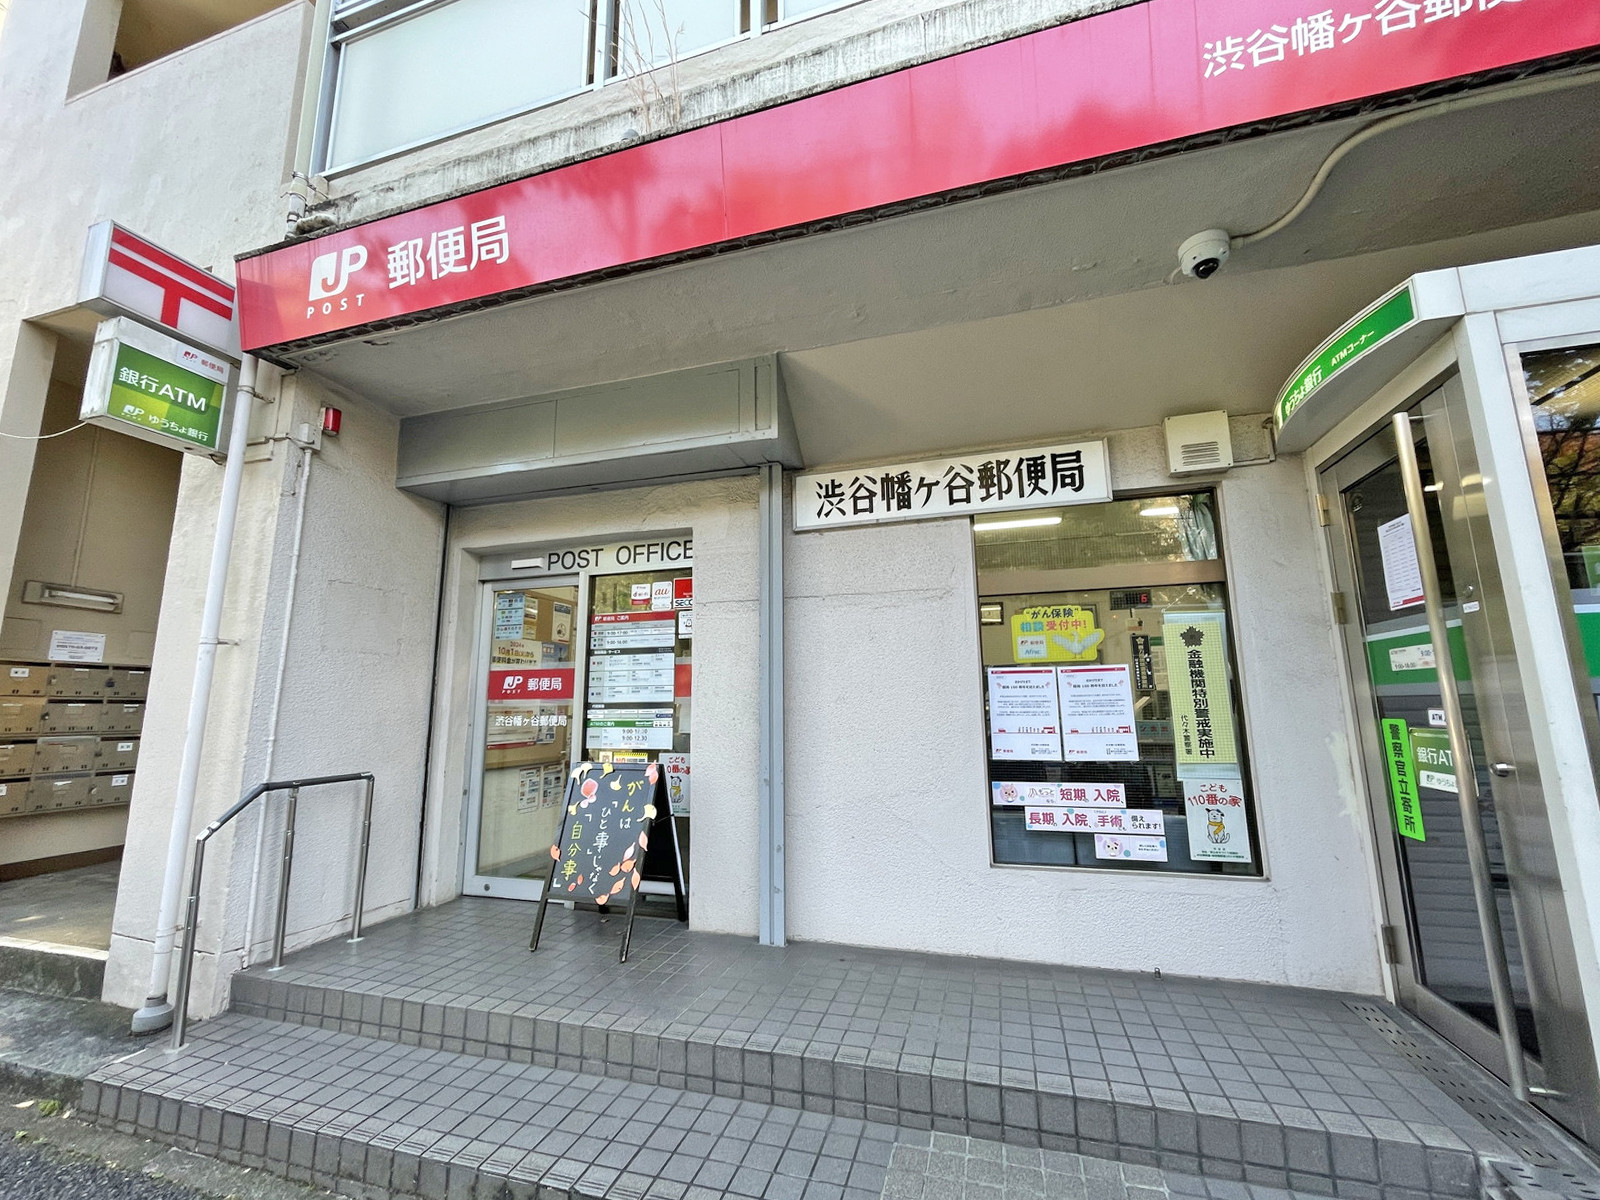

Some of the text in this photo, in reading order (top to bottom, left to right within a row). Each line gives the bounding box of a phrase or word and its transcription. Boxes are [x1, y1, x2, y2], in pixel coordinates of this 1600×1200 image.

[1203, 0, 1523, 79] 渋谷幡ヶ谷郵
[387, 214, 510, 289] 郵便局
[306, 293, 365, 319] POST
[1330, 330, 1375, 367] ATMコーナー
[201, 359, 224, 374] 郵便局
[119, 366, 207, 412] 銀行ATM
[1284, 365, 1322, 416] ゆうちょ銀行
[149, 414, 209, 442] ゆうちょ銀行
[547, 539, 693, 571] POST OFFICE
[654, 588, 670, 596] au
[527, 677, 562, 691] 郵便局
[1187, 649, 1216, 760] 金融機関特別警戒実施中
[1180, 715, 1193, 756] 代々木警察署
[668, 756, 686, 764] こども
[1416, 746, 1454, 767] 銀行AT
[1200, 783, 1228, 793] こども
[1389, 723, 1416, 834] 警察官立寄所
[619, 779, 646, 830] がんは
[1187, 793, 1243, 808] 110番の家
[1130, 814, 1146, 823] 備え
